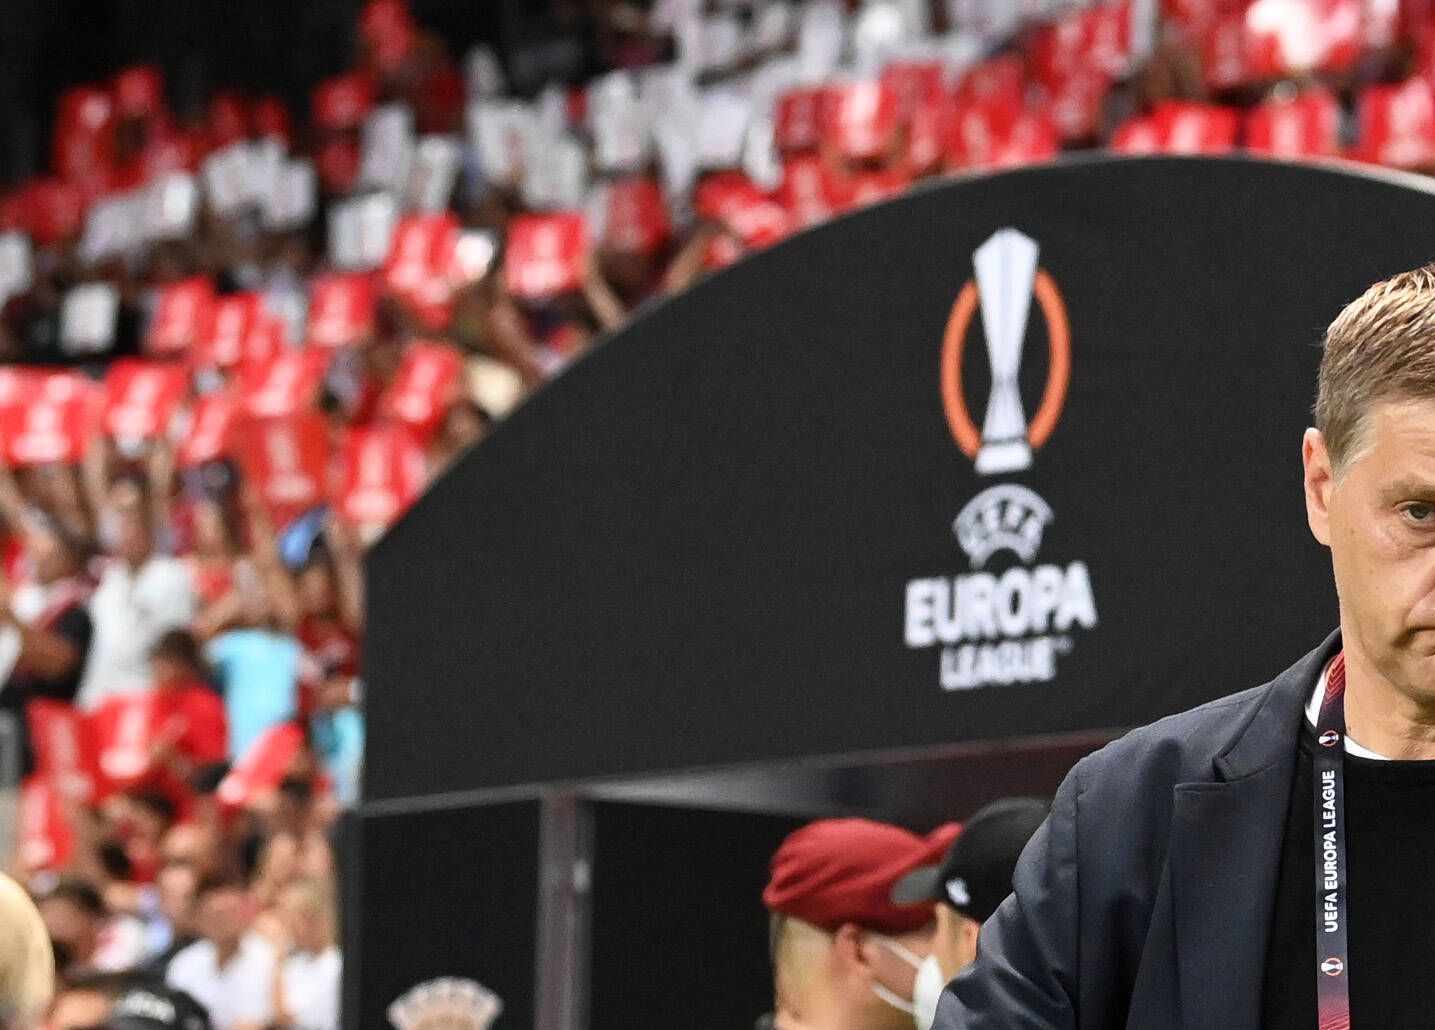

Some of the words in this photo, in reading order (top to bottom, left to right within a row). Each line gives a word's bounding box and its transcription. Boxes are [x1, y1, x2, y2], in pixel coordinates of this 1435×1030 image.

[905, 562, 1096, 647] EUROPA
[1322, 770, 1336, 828] LEAGUE
[1323, 831, 1338, 890] EUROPA
[1324, 892, 1338, 933] UEFA
